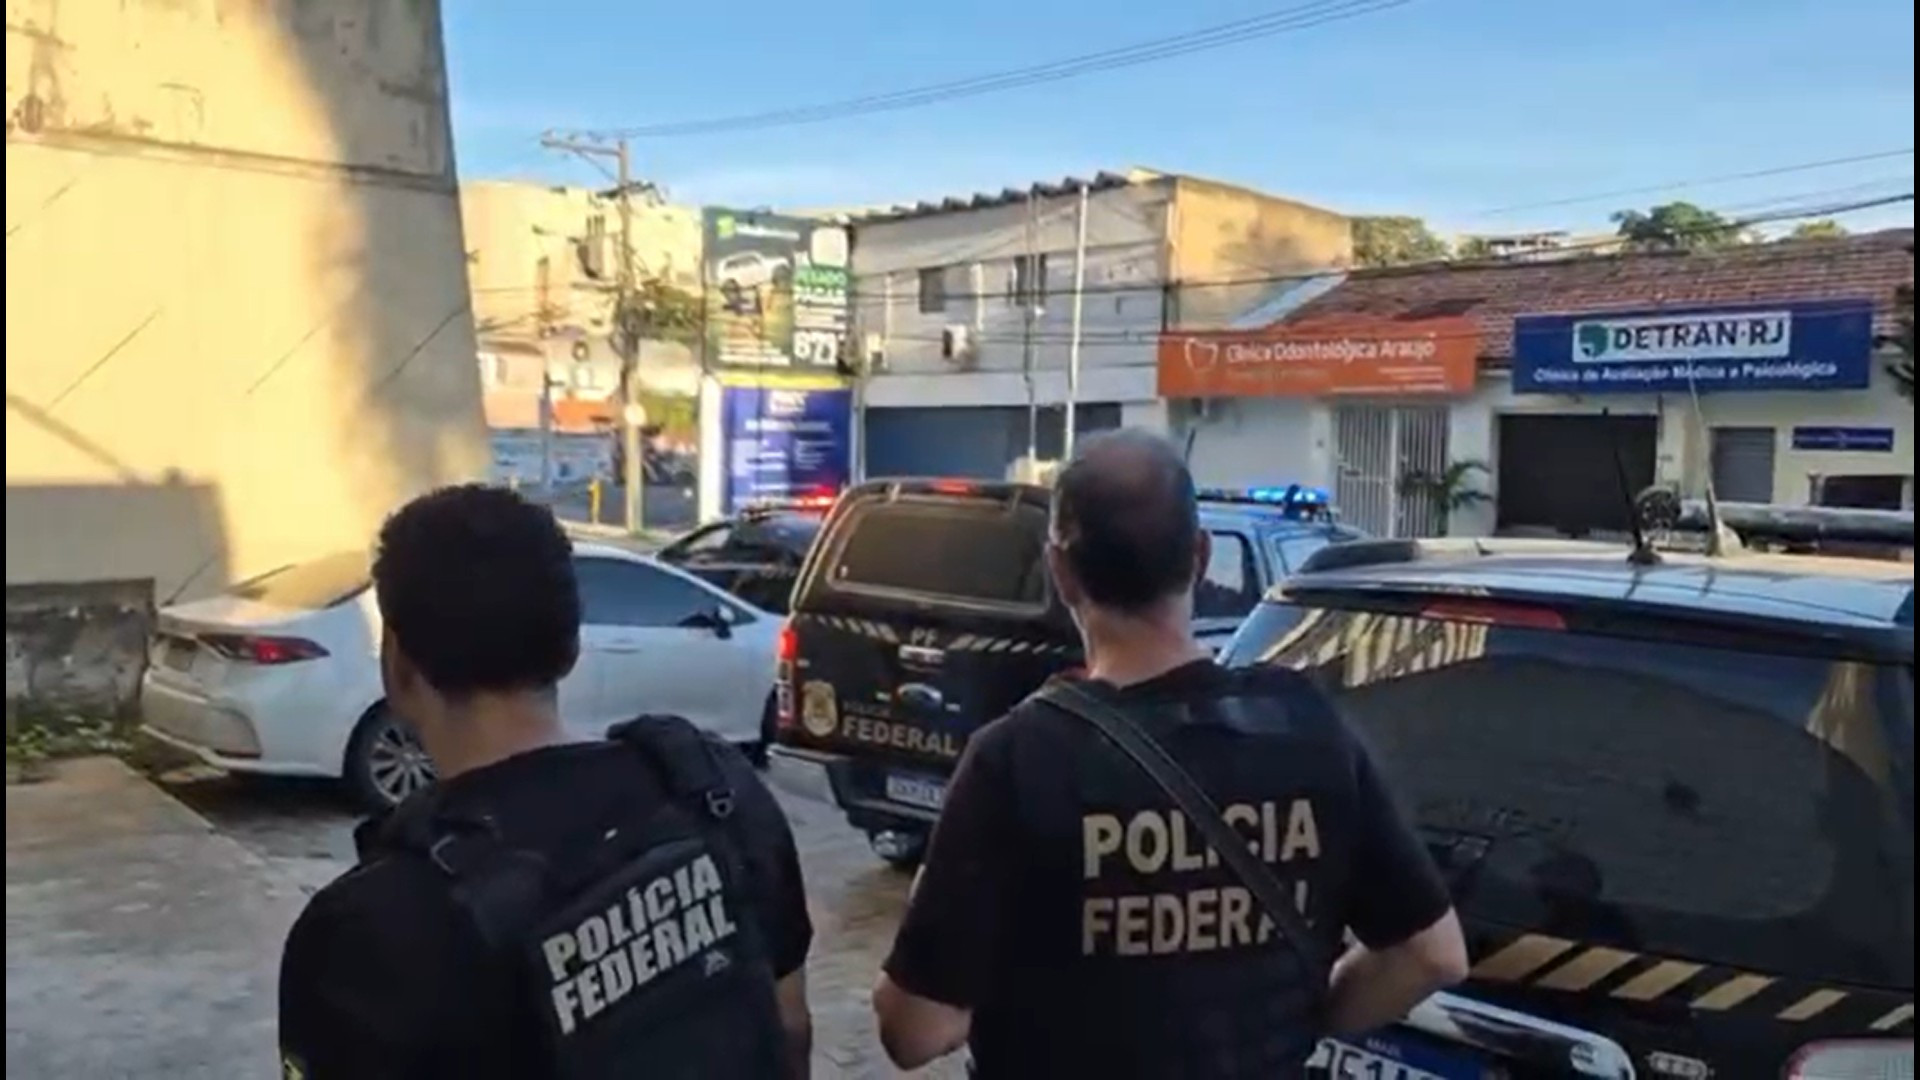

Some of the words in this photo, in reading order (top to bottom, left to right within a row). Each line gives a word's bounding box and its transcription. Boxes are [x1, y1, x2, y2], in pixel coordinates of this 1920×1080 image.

[911, 627, 939, 647] PF
[842, 716, 960, 757] FEDERAL
[1082, 798, 1321, 879] POLCIA
[551, 894, 737, 1036] FEDERAL
